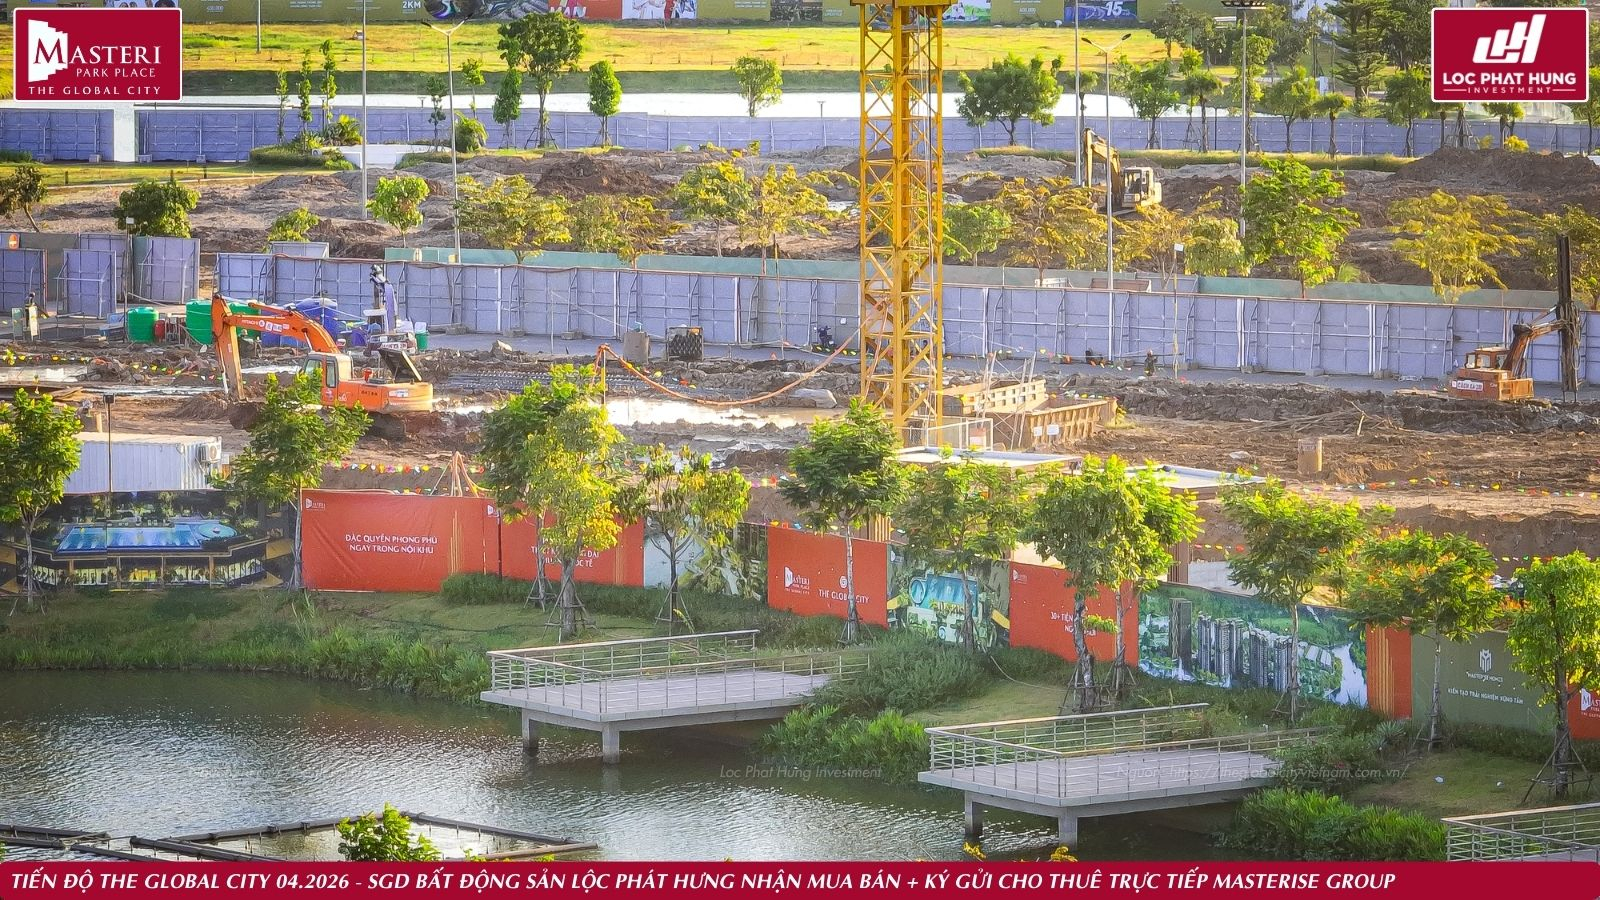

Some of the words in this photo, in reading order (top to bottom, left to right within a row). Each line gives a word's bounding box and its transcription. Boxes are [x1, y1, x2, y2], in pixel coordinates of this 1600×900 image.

[392, 535, 420, 544] PHONG
[349, 544, 372, 552] NGAY
[372, 545, 400, 553] TRONG
[417, 546, 434, 554] KHU
[818, 589, 830, 599] THE
[855, 595, 870, 604] CITY
